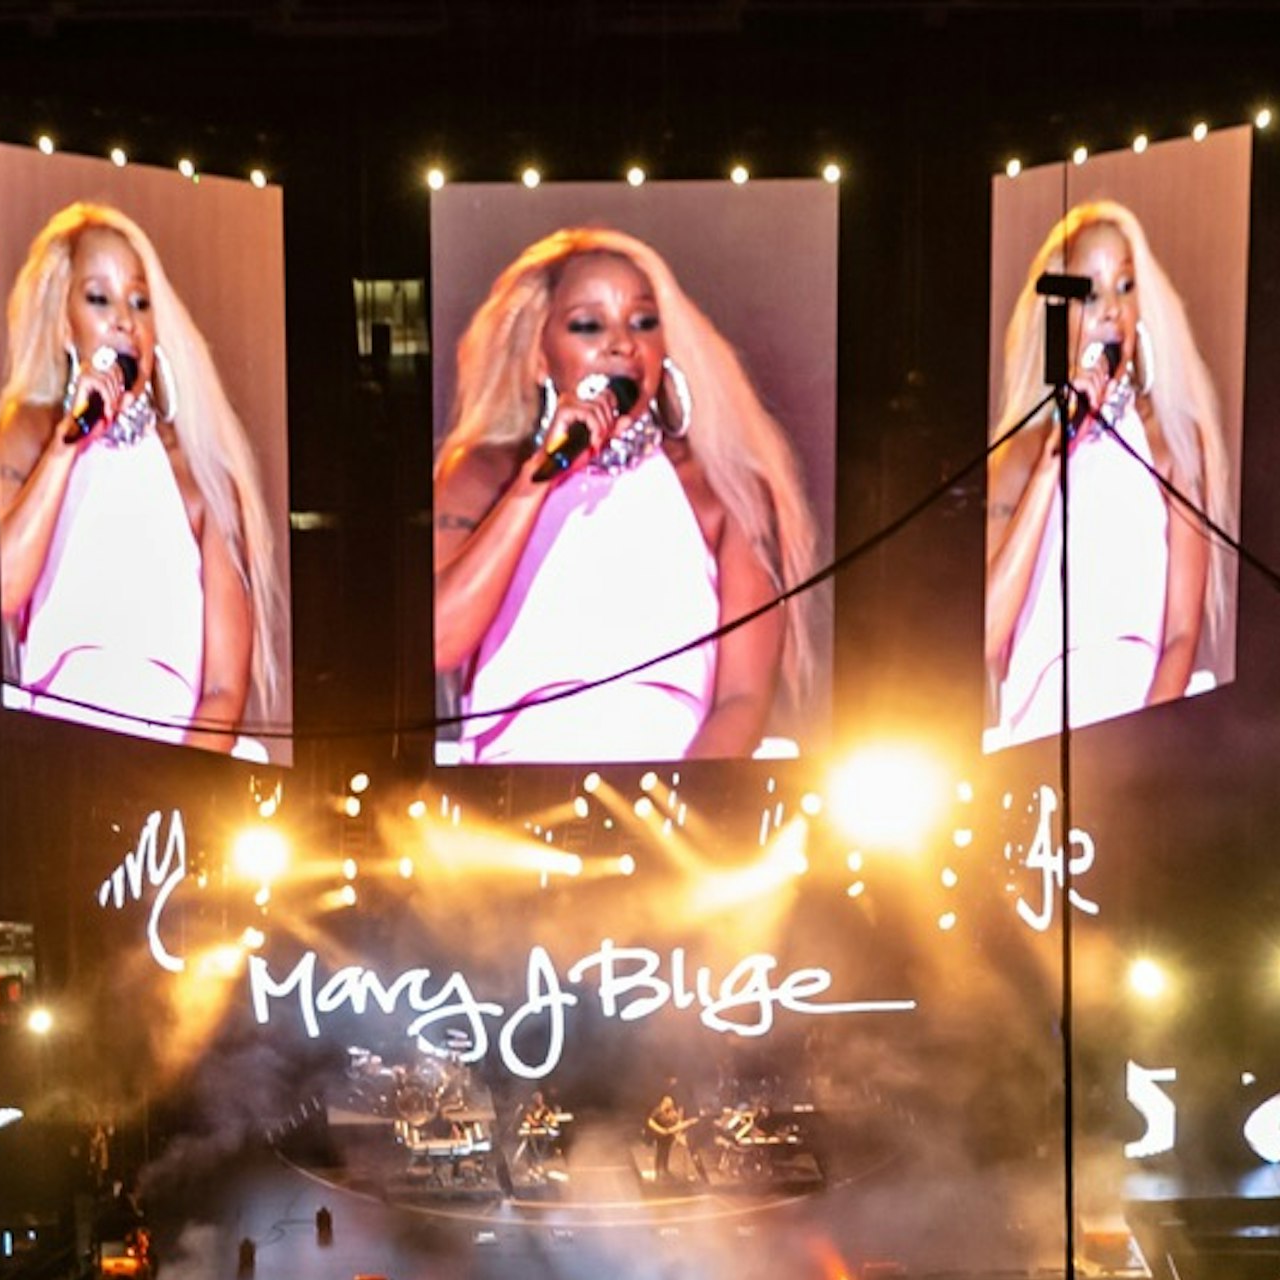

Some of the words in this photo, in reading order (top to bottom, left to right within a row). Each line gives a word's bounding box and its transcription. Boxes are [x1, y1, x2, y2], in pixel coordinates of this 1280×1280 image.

[249, 951, 503, 1062] Mary
[499, 945, 577, 1079] J
[569, 938, 918, 1036] Blige
